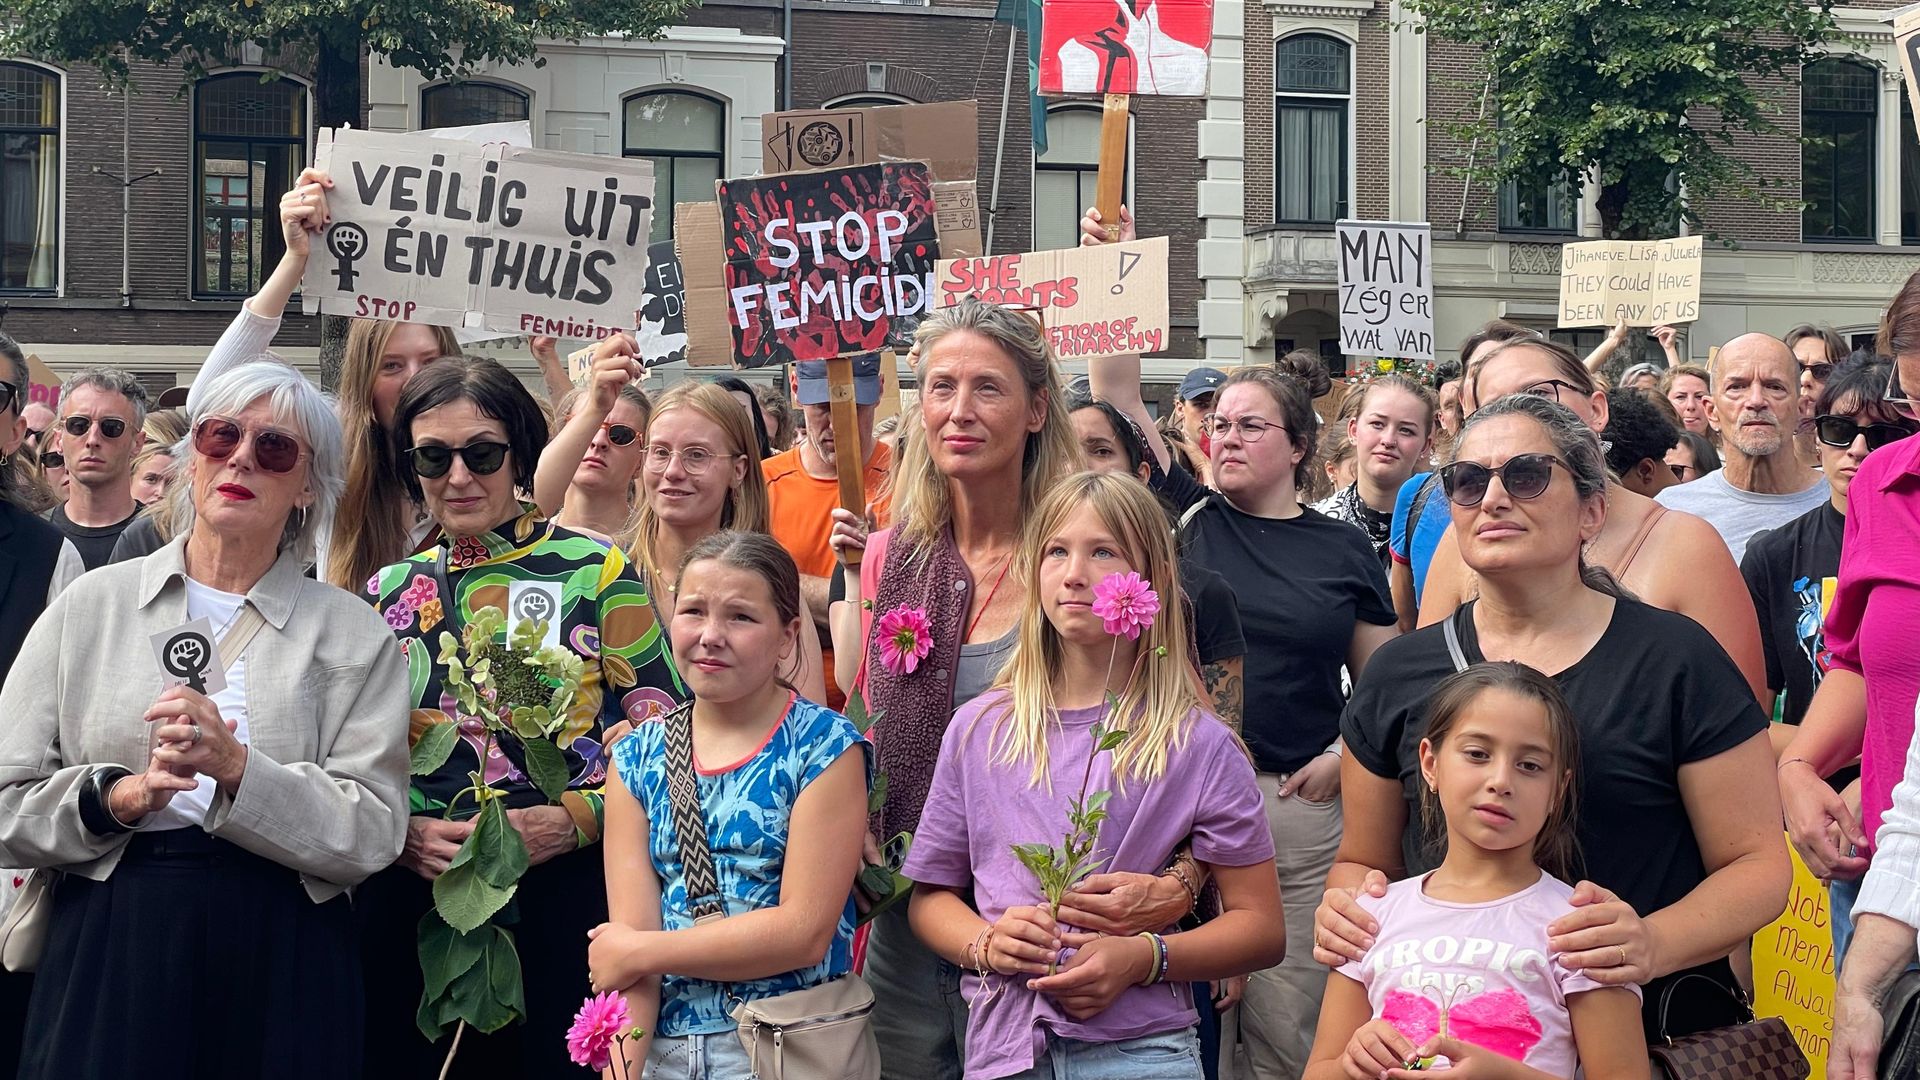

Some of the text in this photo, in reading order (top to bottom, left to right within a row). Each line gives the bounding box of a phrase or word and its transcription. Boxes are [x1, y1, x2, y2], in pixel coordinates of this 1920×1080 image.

[384, 216, 448, 277] ÉN
[764, 210, 909, 268] STOP
[941, 254, 1022, 293] SHE
[1340, 229, 1423, 288] MAN
[1563, 273, 1605, 294] THEY
[1658, 272, 1693, 291] HAVE
[355, 295, 417, 320] STOP
[1615, 303, 1646, 321] ANY
[1652, 301, 1672, 321] OF
[1676, 300, 1697, 318] US
[1110, 316, 1138, 336] OF
[1371, 935, 1549, 983] TROPIC
[1401, 964, 1486, 996] days
